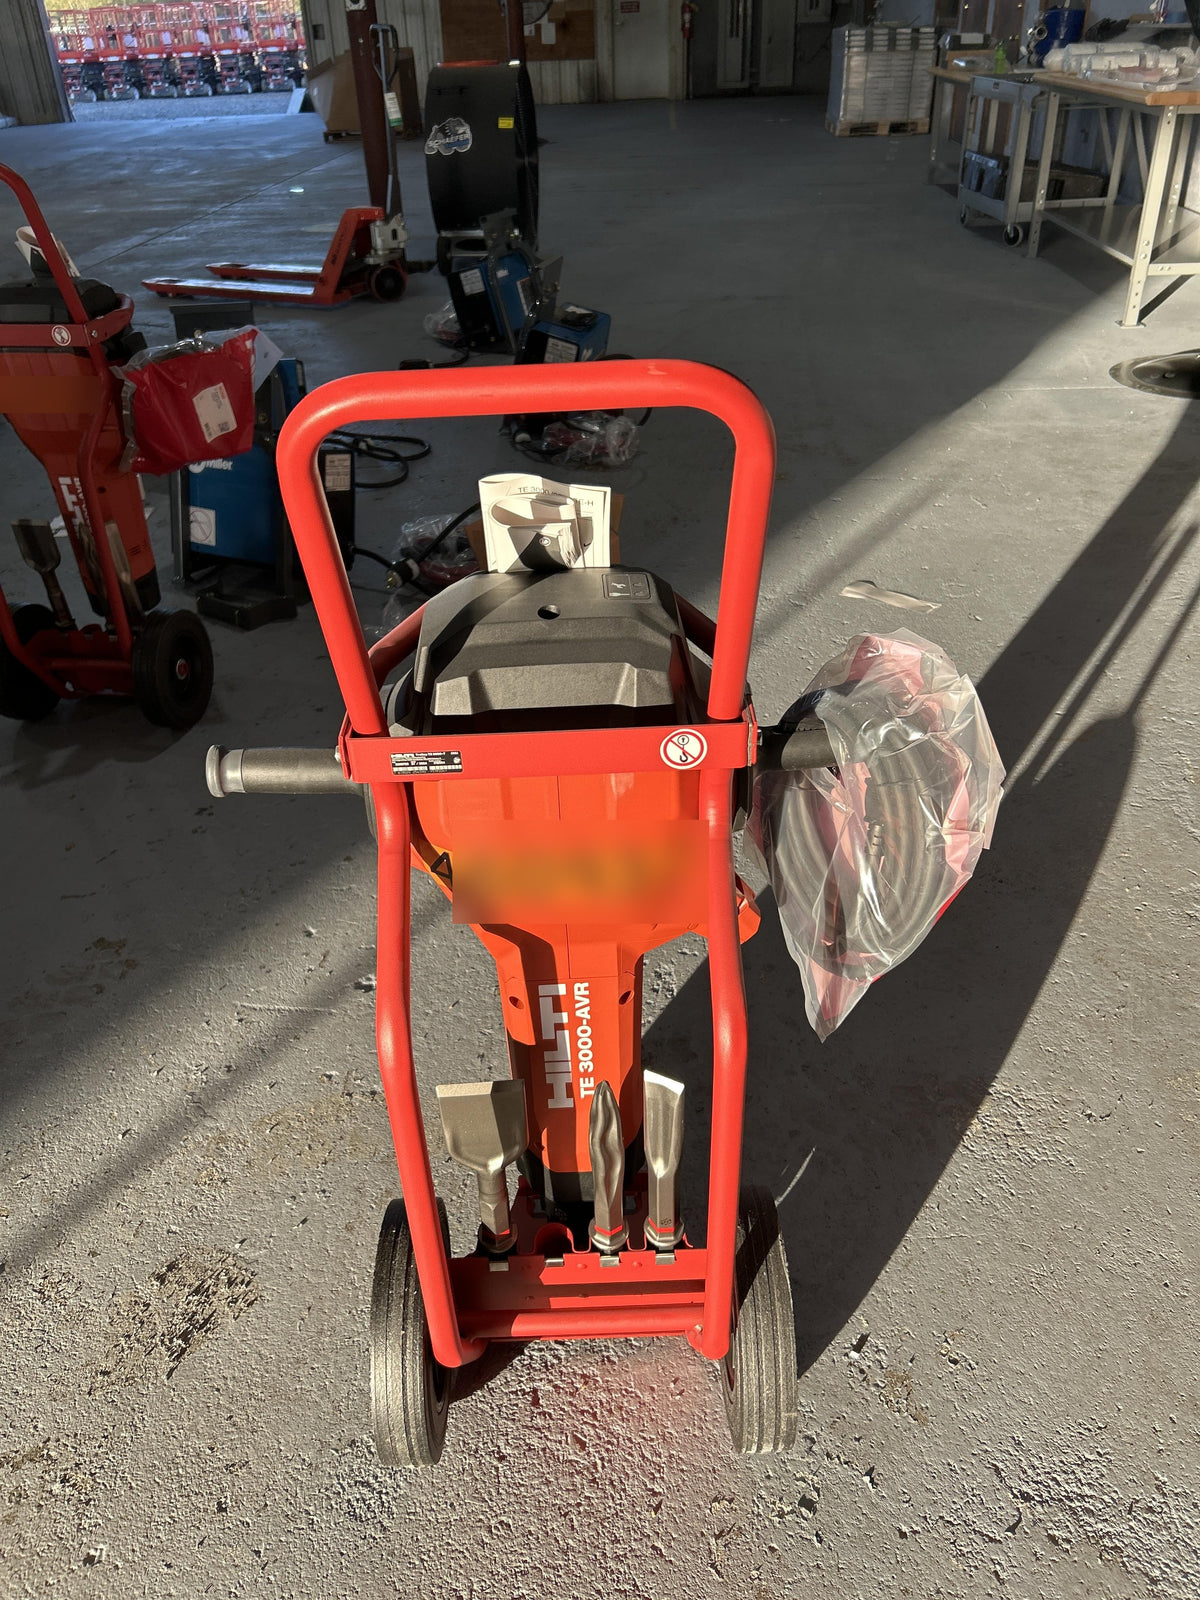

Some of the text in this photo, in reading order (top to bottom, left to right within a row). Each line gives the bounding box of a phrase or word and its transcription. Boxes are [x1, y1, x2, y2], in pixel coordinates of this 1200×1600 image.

[538, 983, 574, 1108] HILTI
[573, 982, 595, 1099] TE 3000-AVR
